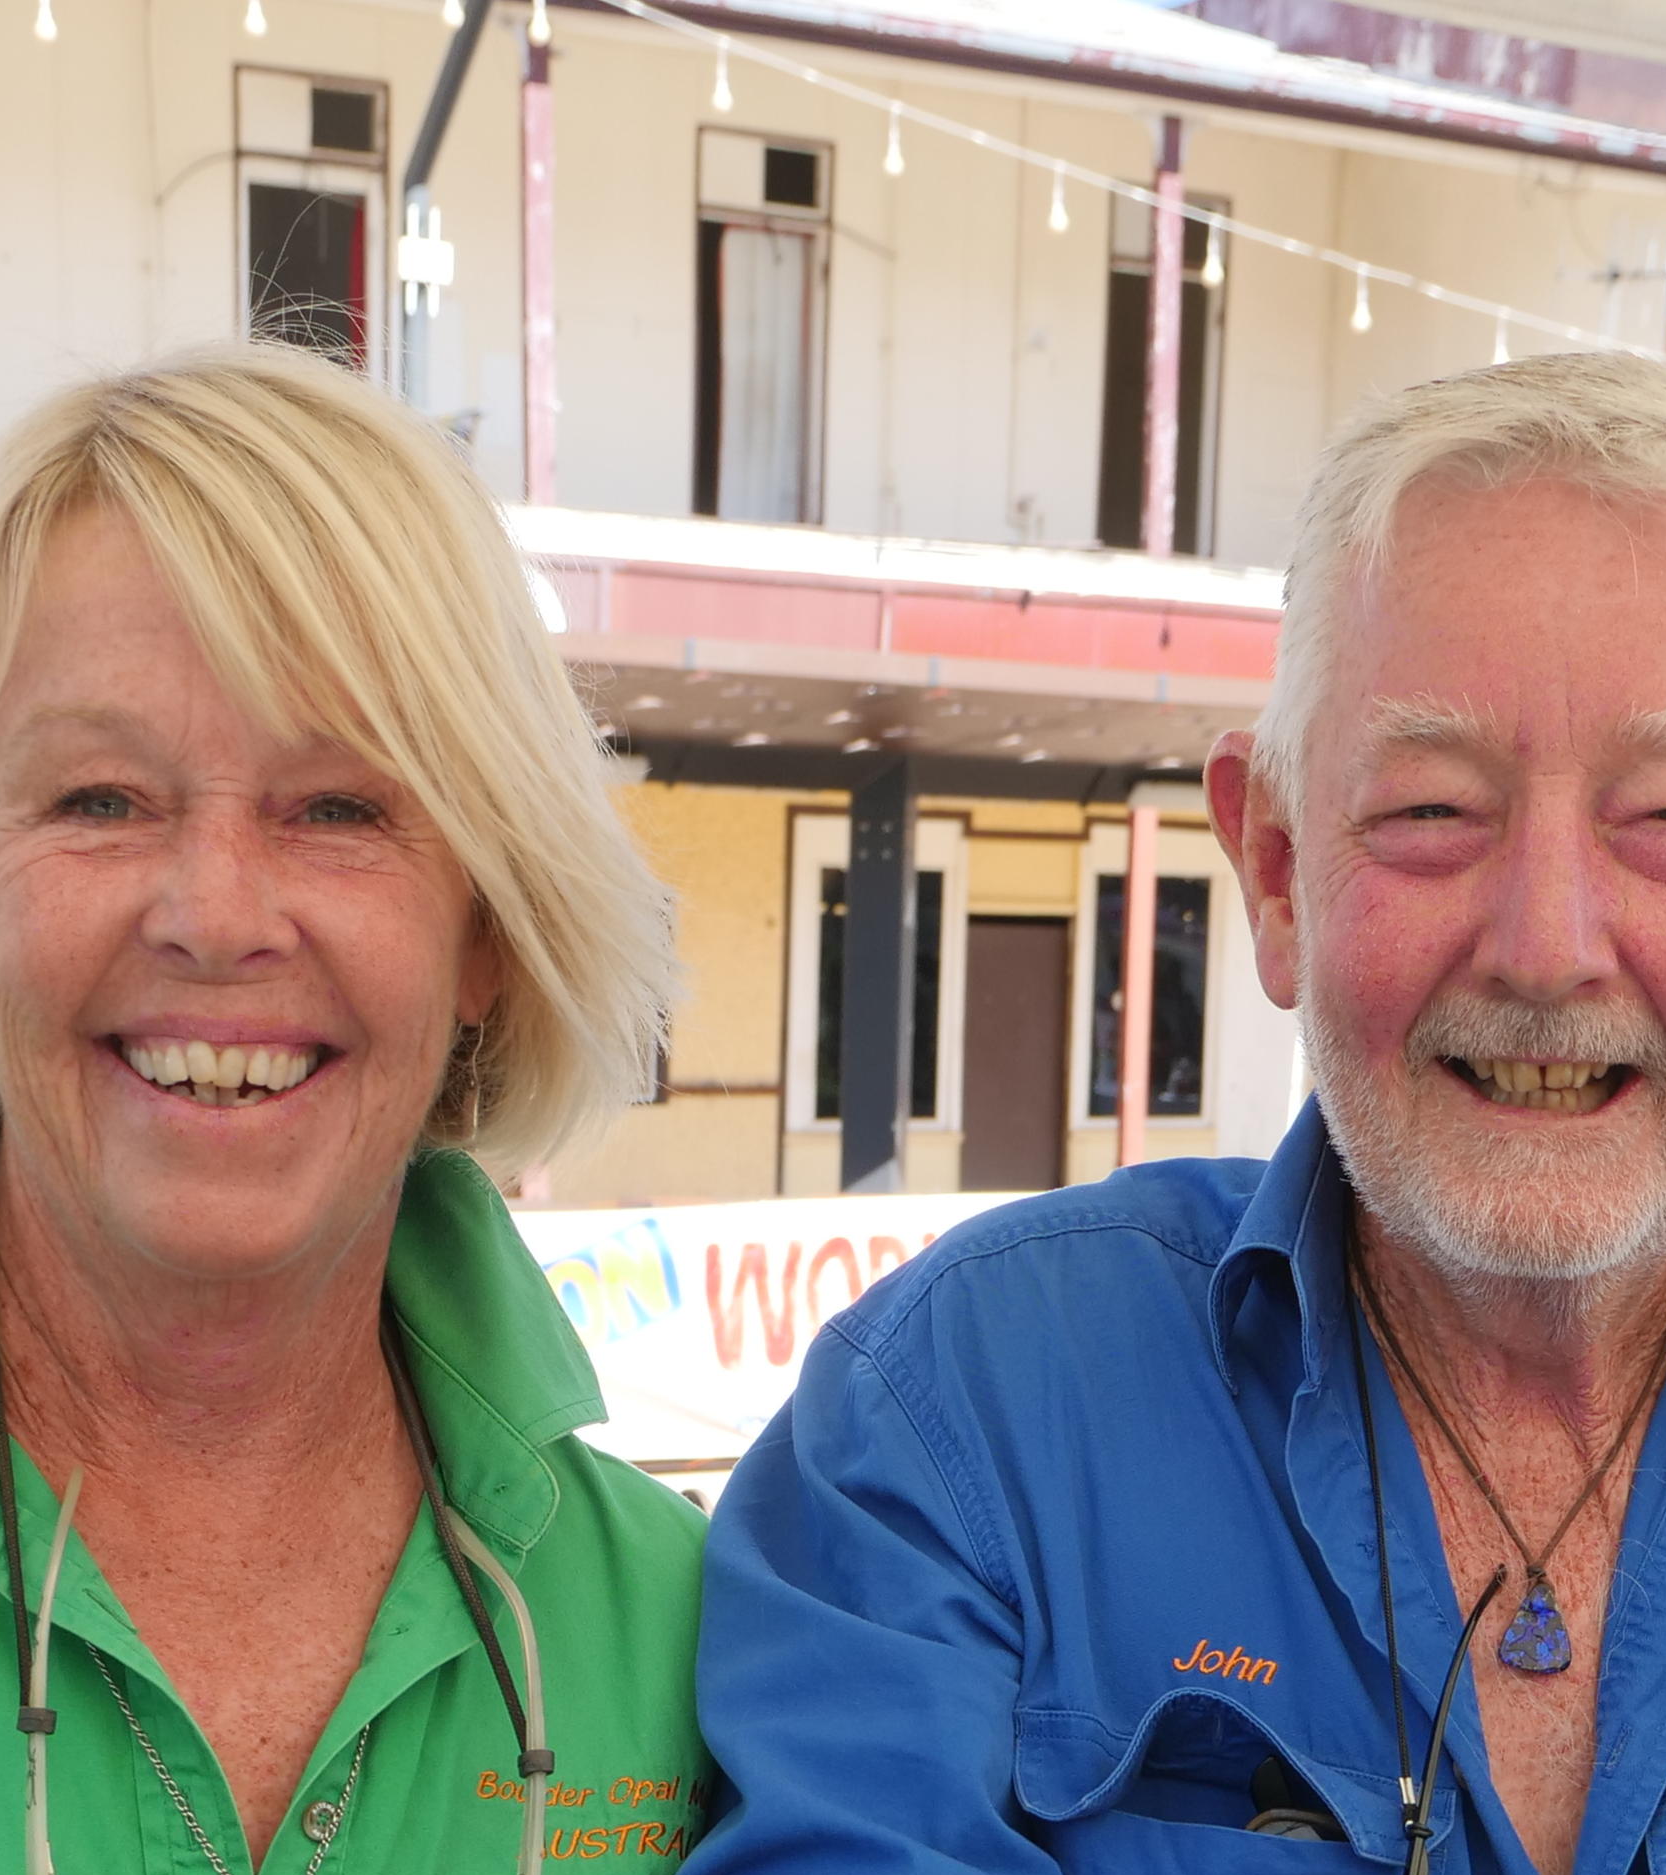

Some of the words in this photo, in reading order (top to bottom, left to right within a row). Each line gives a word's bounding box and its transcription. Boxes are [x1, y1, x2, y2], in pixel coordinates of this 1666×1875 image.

[1173, 1639, 1278, 1686] John
[476, 1770, 596, 1807] Bouder
[608, 1776, 681, 1808] Opal
